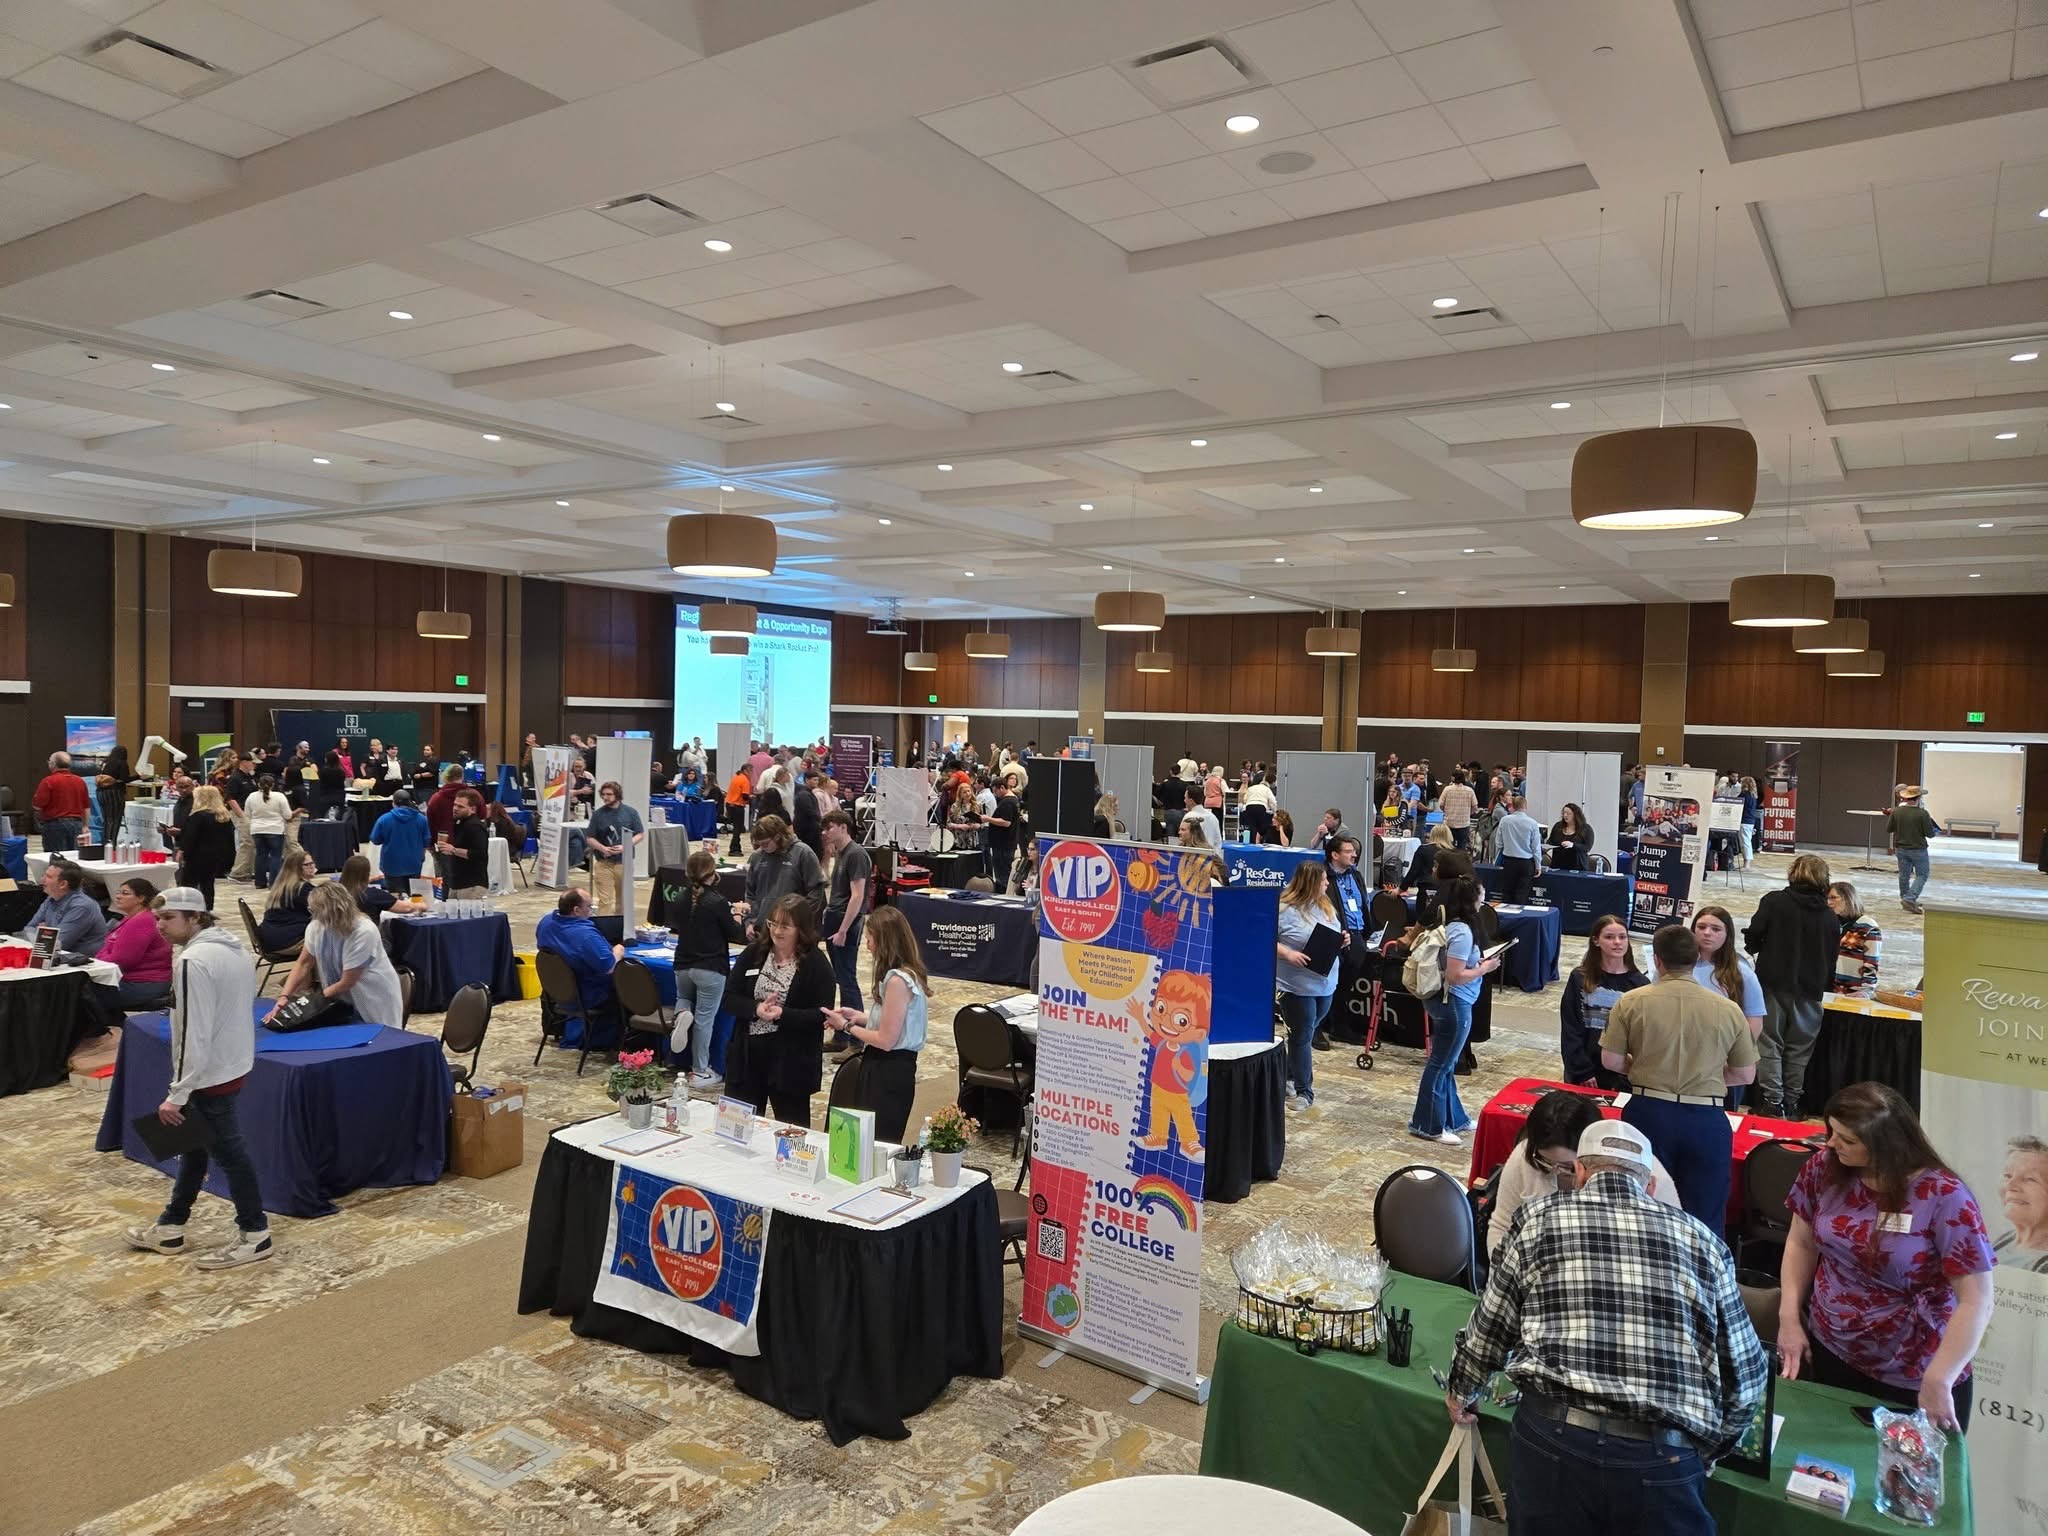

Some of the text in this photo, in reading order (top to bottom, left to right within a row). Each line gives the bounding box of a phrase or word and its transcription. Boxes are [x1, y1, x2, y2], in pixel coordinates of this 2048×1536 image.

[771, 621, 810, 634] Opportunity
[810, 624, 827, 635] Expo
[687, 636, 699, 644] You
[769, 642, 785, 650] Shark
[1772, 797, 1789, 807] OUR
[1765, 808, 1795, 818] FUTURE
[1775, 819, 1783, 828] IS
[1764, 830, 1795, 840] BRIGHT
[1640, 846, 1667, 858] Jump
[1640, 859, 1660, 868] start
[1051, 856, 1110, 898] VIP
[1246, 868, 1284, 880] ResCare
[1639, 871, 1659, 879] your
[1637, 882, 1665, 892] career.
[1044, 896, 1116, 911] KINDER COLLEGE
[931, 922, 977, 932] Providence
[1062, 917, 1076, 931] Est.
[939, 931, 976, 940] HealthCare
[1083, 951, 1131, 965] Where Passion
[1079, 959, 1099, 967] Meets
[1101, 962, 1127, 972] Purpose
[1080, 967, 1132, 982] Early Childhood
[1090, 977, 1123, 988] Education
[1043, 984, 1086, 1007] JOIN
[1962, 978, 2048, 1010] Rewa
[1041, 1001, 1128, 1033] THE TEAM!
[1978, 1017, 2044, 1040] JOIN
[2006, 1052, 2048, 1066] AT WE
[1041, 1088, 1112, 1117] MULTIPLE
[1036, 1102, 1120, 1136] LOCATIONS
[785, 1138, 818, 1155] CONGRATS!
[1095, 1180, 1154, 1215] 100%
[1095, 1203, 1148, 1235] FREE
[662, 1204, 714, 1254] VIP
[1091, 1221, 1175, 1262] COLLEGE
[653, 1243, 682, 1259] KINDER
[665, 1257, 680, 1265] EAST
[684, 1265, 704, 1276] SOUTH
[2018, 1290, 2048, 1304] satisf
[1994, 1298, 2032, 1314] Valley's
[1979, 1398, 2045, 1432] (812)
